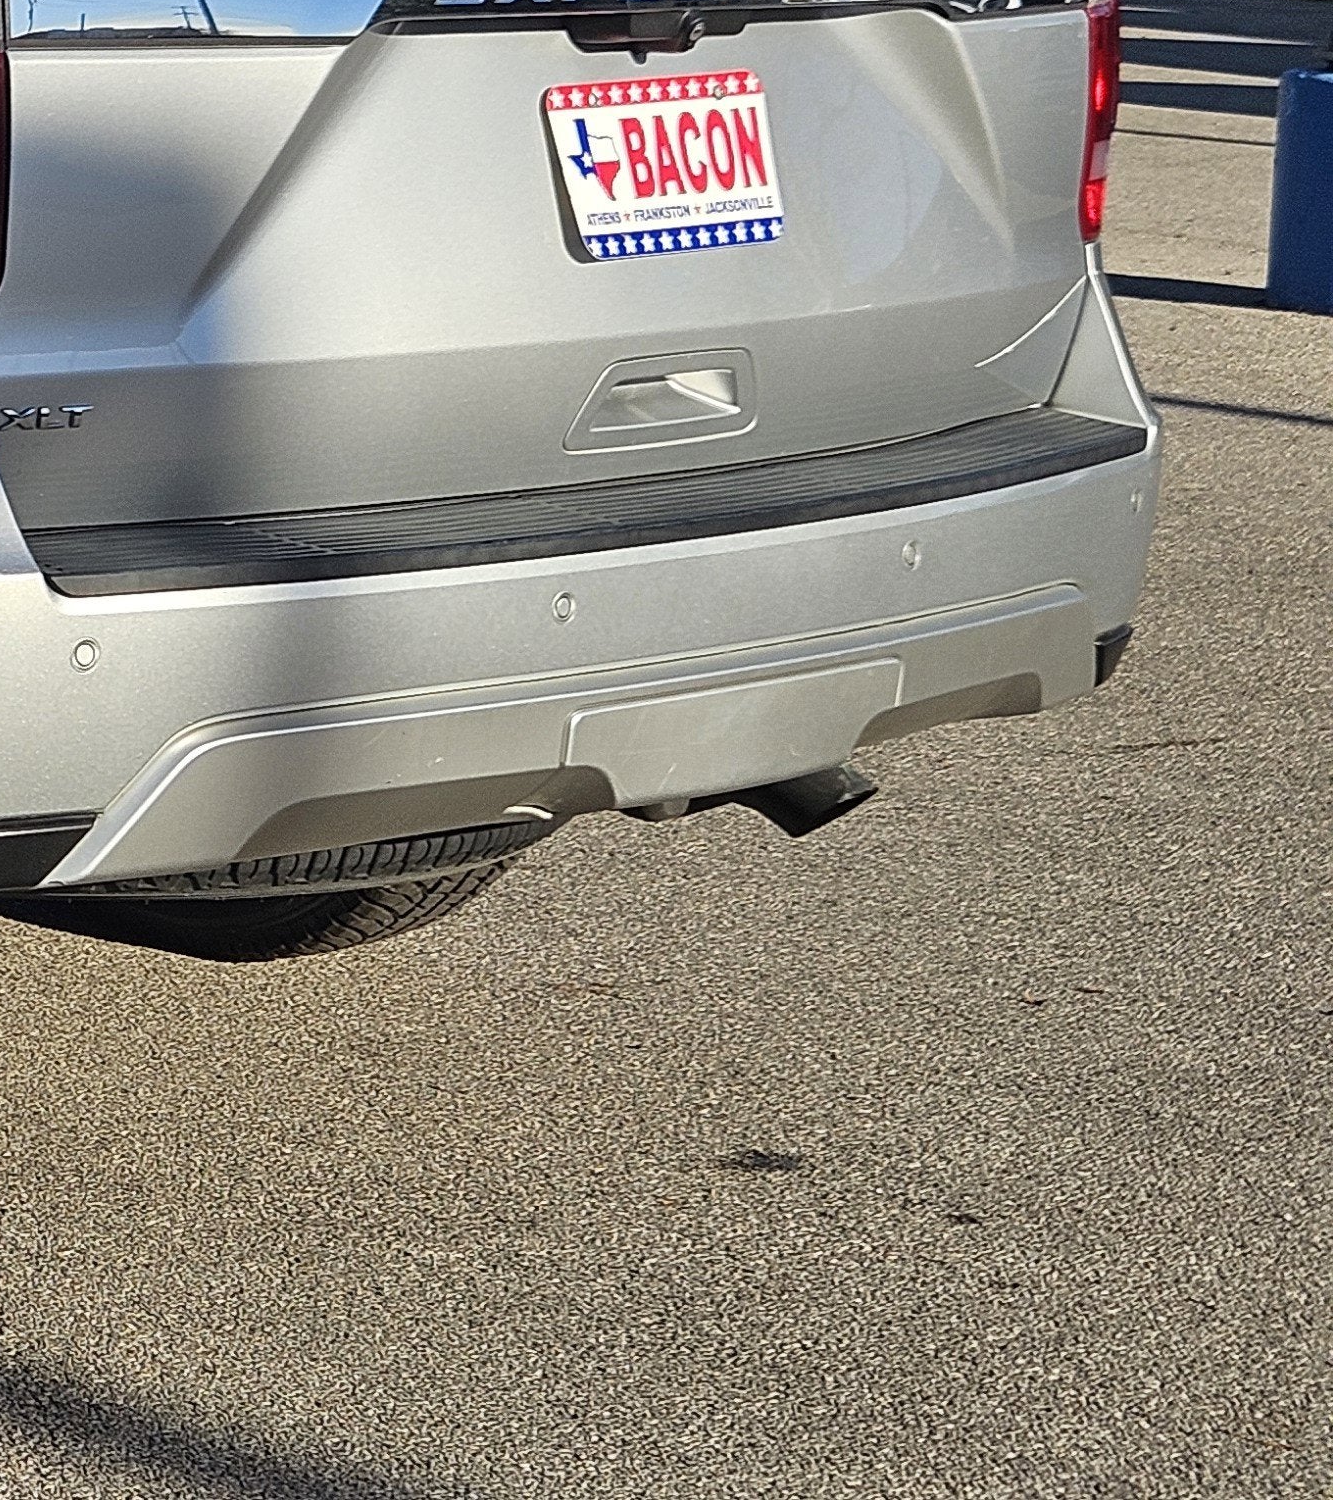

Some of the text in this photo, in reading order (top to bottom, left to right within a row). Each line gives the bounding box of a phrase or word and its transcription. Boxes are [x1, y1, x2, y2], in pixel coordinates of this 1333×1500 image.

[618, 106, 768, 199] BACON
[586, 196, 775, 226] ATHENS FRANKSTON JACKSONVILLE
